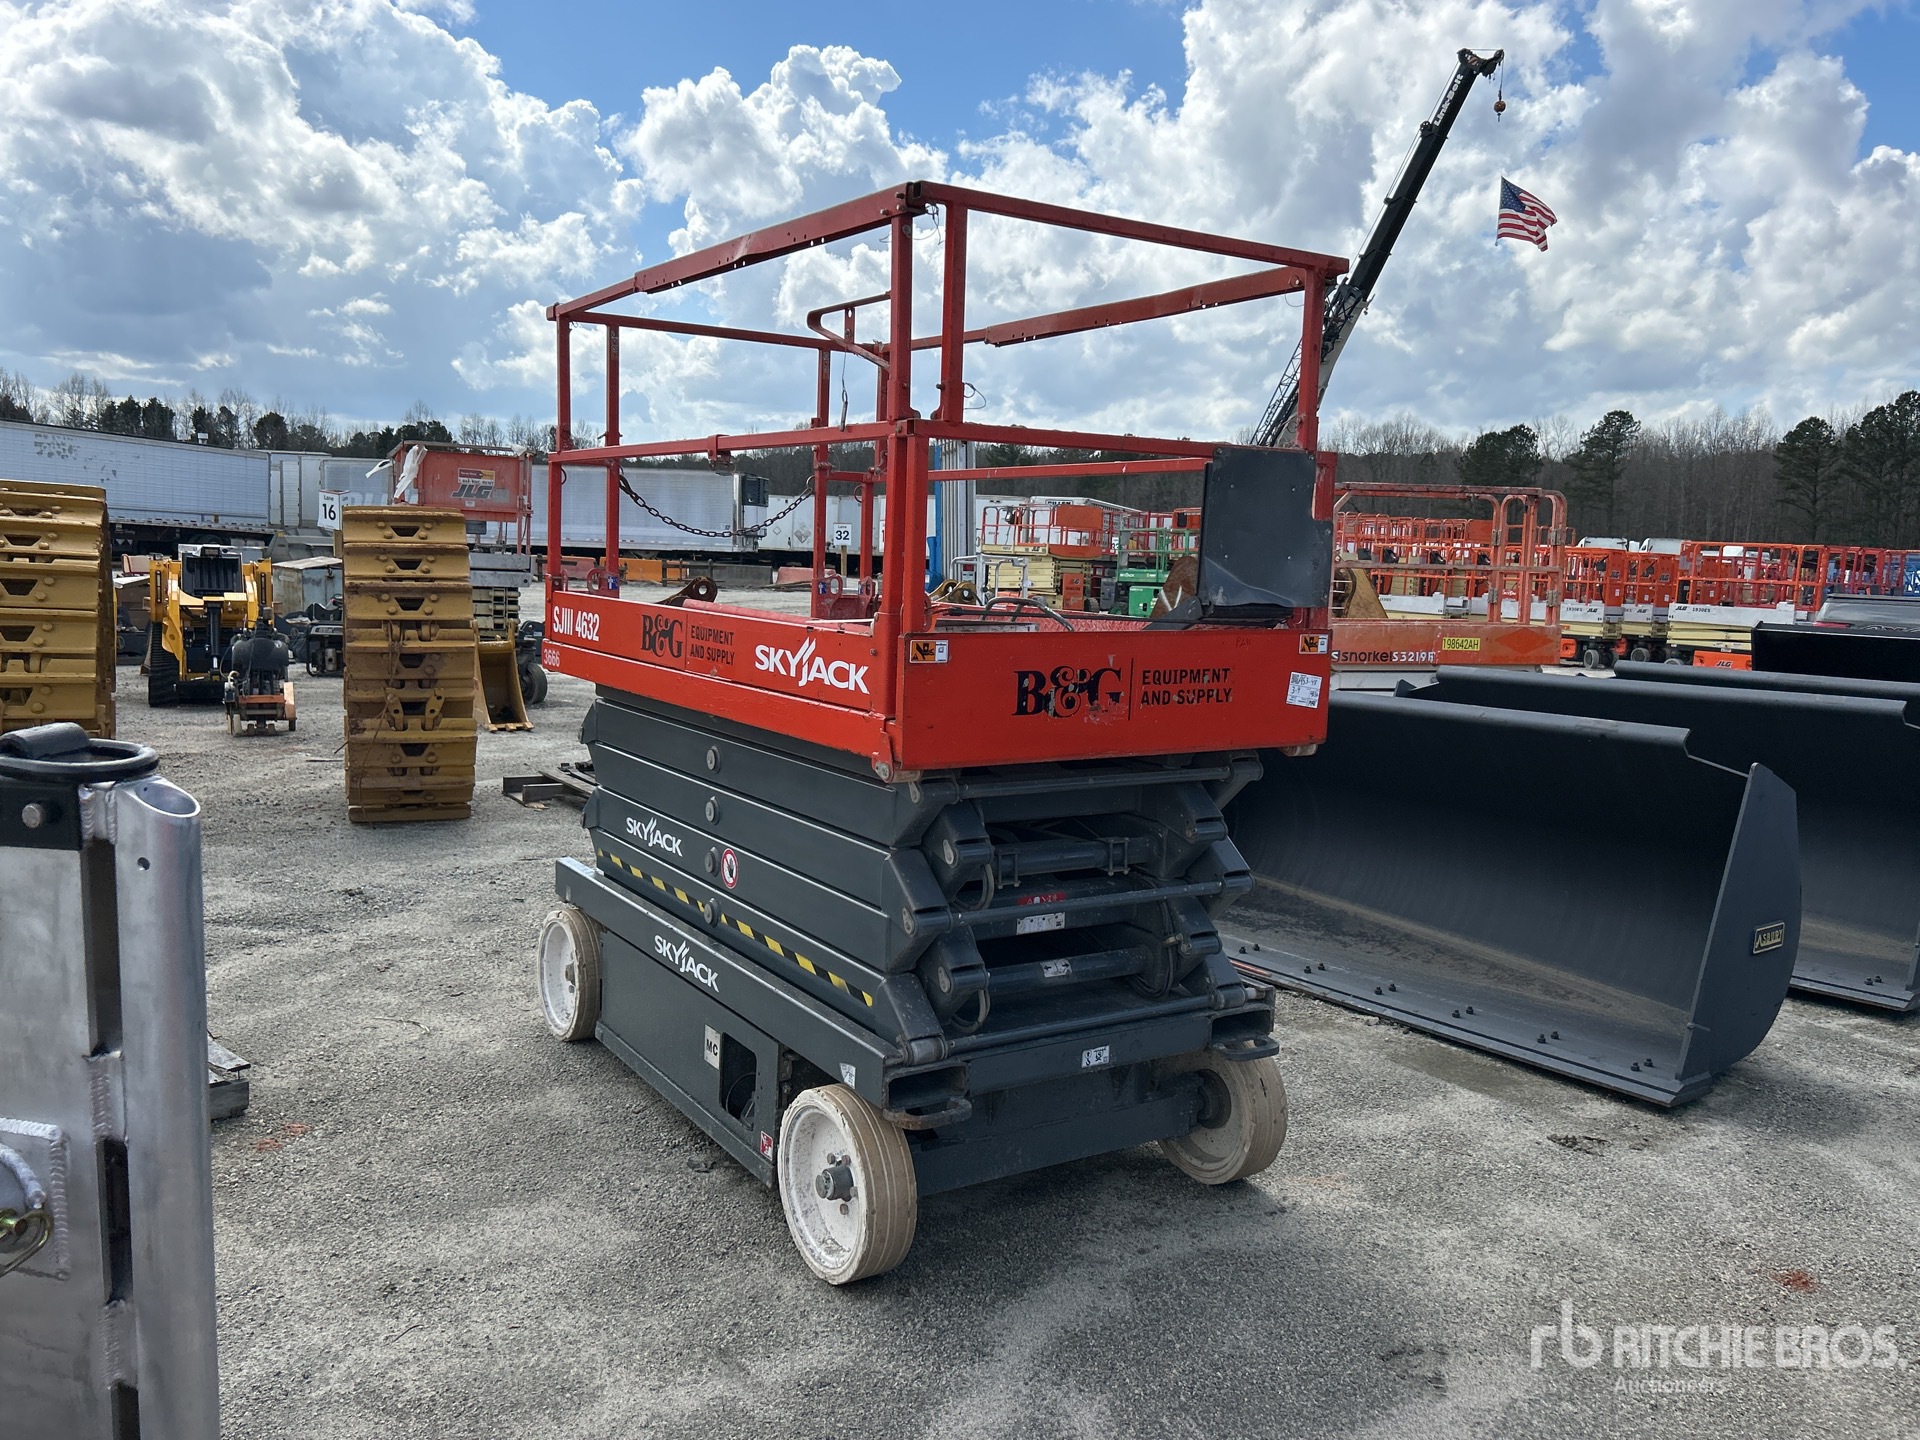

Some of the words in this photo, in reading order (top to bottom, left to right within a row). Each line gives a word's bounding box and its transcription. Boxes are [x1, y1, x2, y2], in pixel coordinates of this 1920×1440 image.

[451, 484, 494, 499] JLG
[322, 503, 337, 521] 16
[835, 530, 850, 541] 32
[575, 611, 600, 641] 4632
[691, 625, 735, 646] EQUIPMENT
[641, 613, 684, 659] B&G
[1442, 637, 1480, 650] 198642AH
[543, 648, 560, 667] 3666
[690, 644, 704, 659] AND
[707, 647, 736, 666] SUPPLY
[1340, 651, 1393, 662] snorkel
[1716, 660, 1733, 668] JLG
[754, 636, 871, 695] SKYJACK
[1142, 667, 1232, 686] EQUIPMENT
[1011, 665, 1125, 719] B&G
[1141, 690, 1171, 706] AND
[1176, 688, 1233, 705] SUPPLY
[625, 816, 683, 857] SKYJACK
[654, 935, 720, 993] SKYJACK
[706, 1038, 719, 1057] MC
